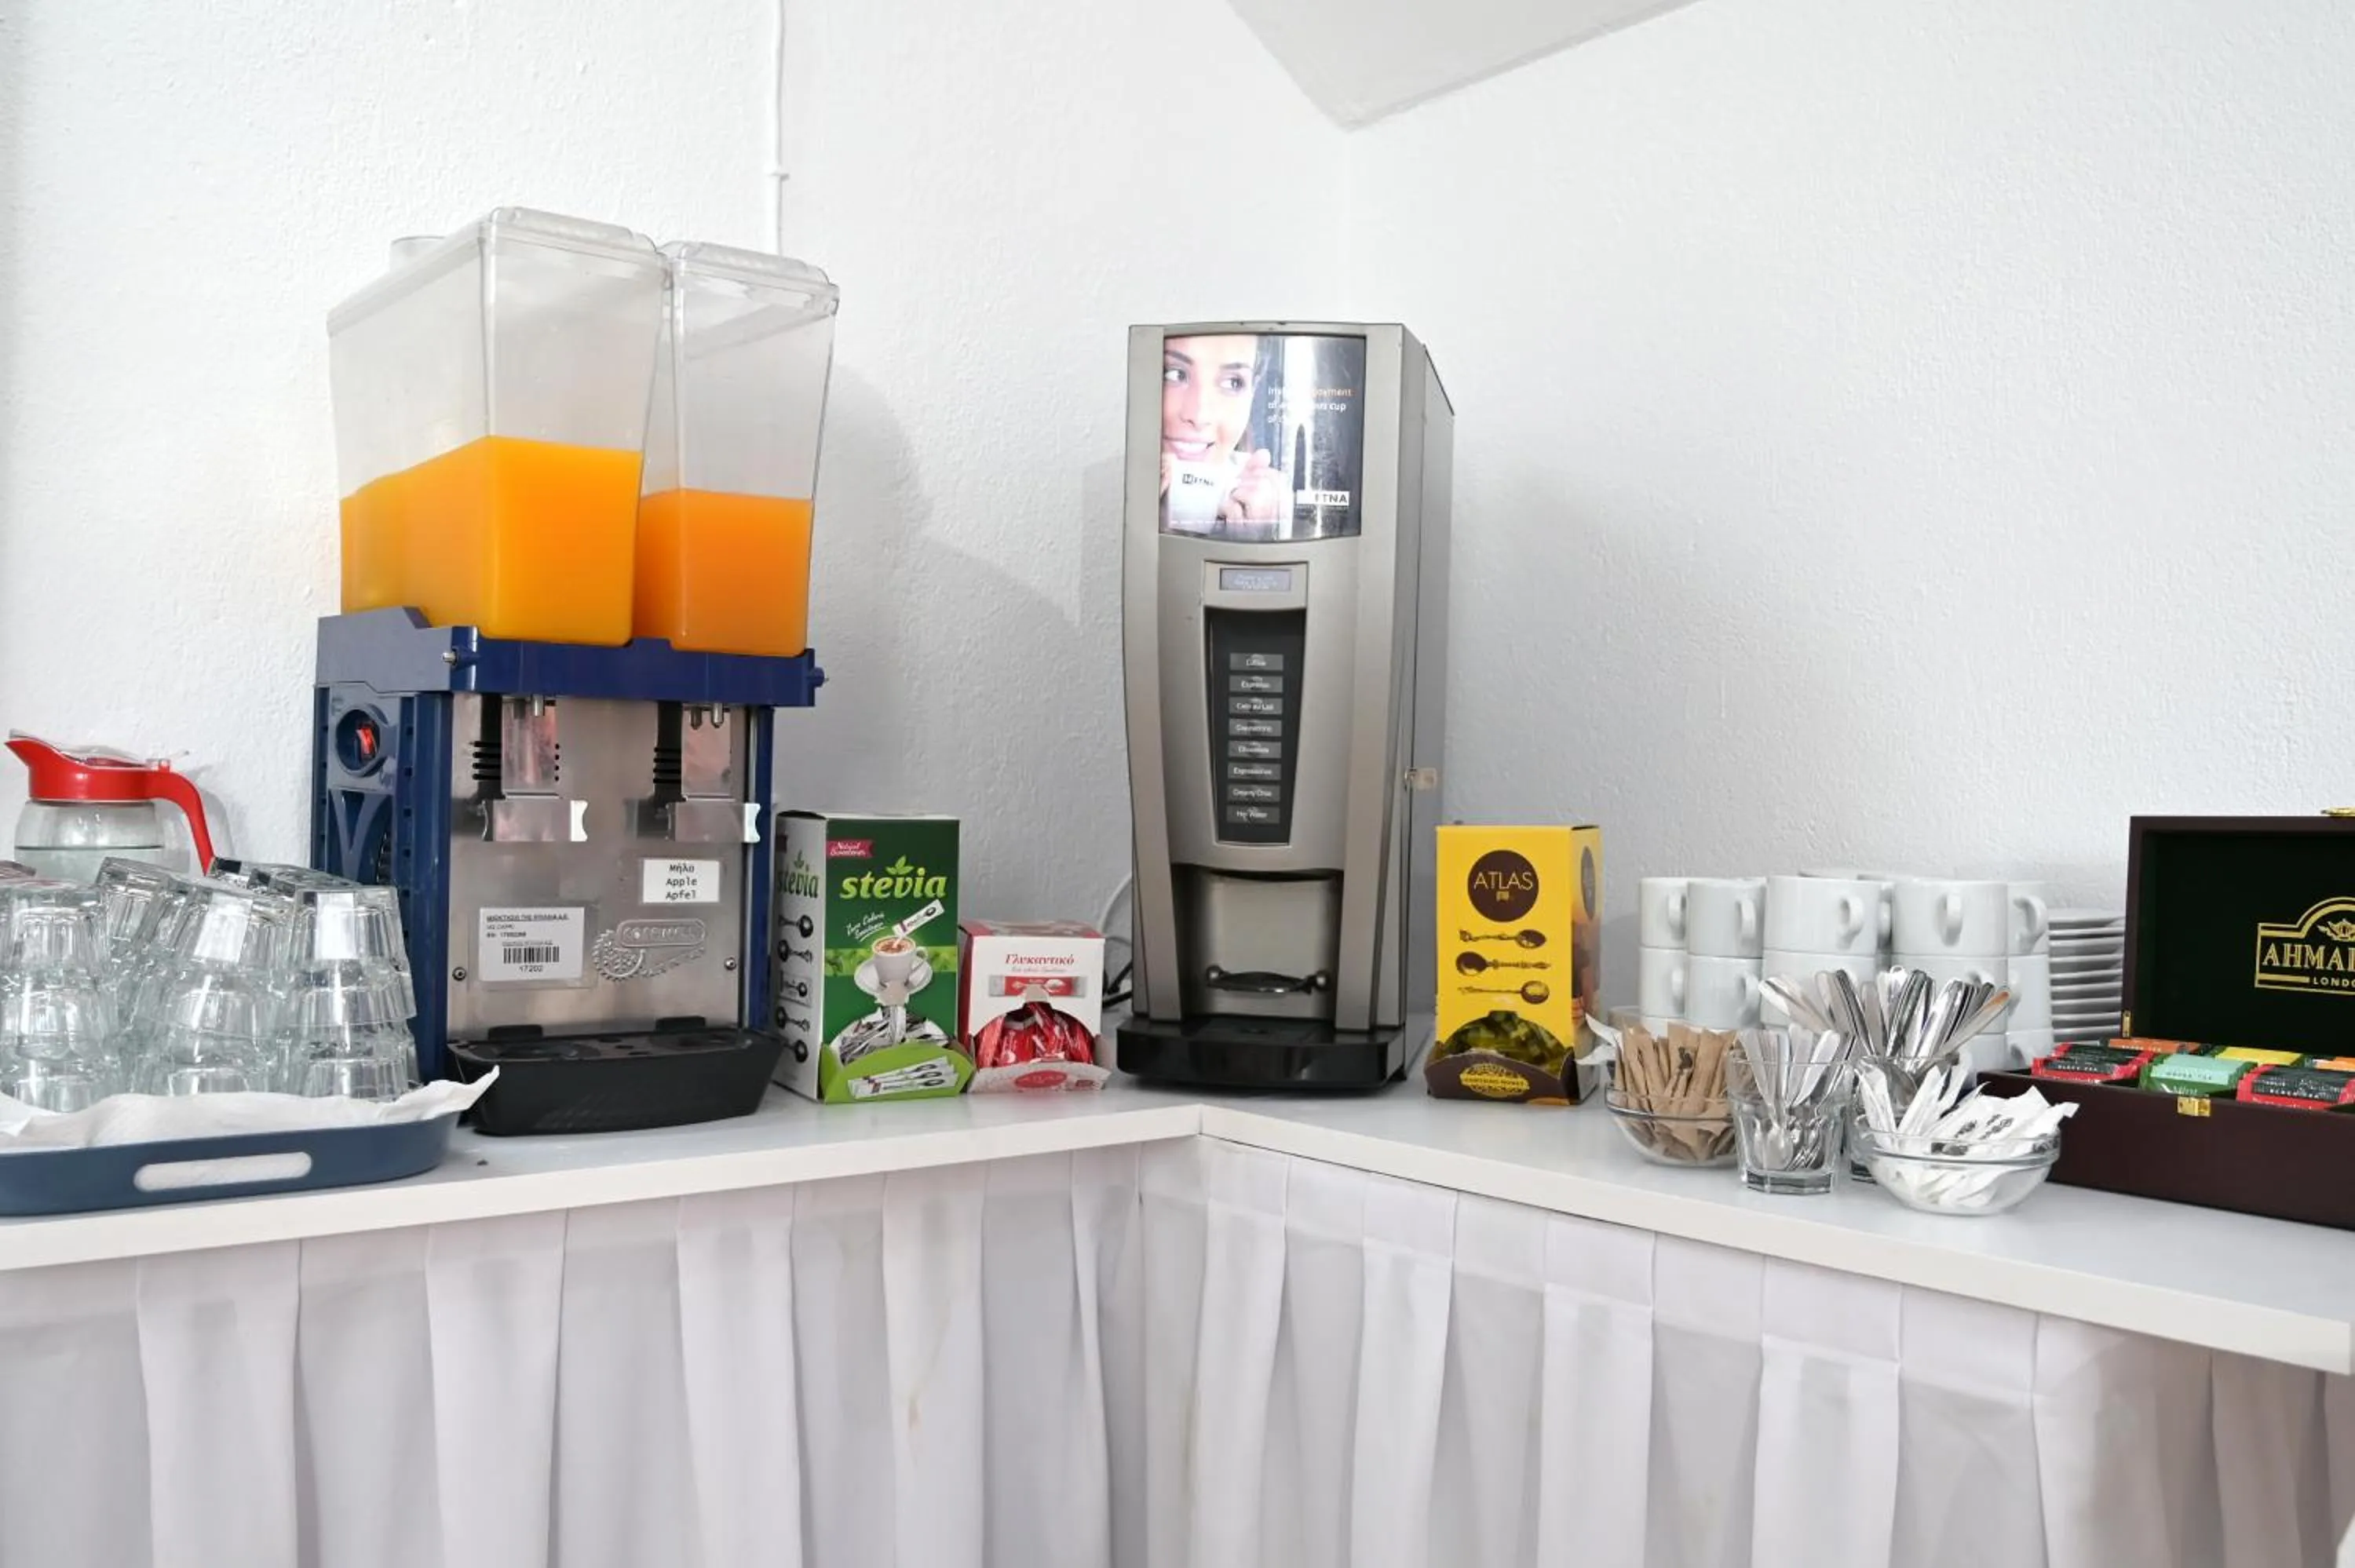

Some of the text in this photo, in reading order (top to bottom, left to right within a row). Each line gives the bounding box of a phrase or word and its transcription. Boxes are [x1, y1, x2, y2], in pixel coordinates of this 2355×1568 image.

[666, 876, 698, 888] Apple
[839, 867, 947, 899] stevia
[1473, 871, 1533, 891] ATLAS
[666, 889, 696, 900] Apfel
[1006, 954, 1075, 965] Γλυκαντικό
